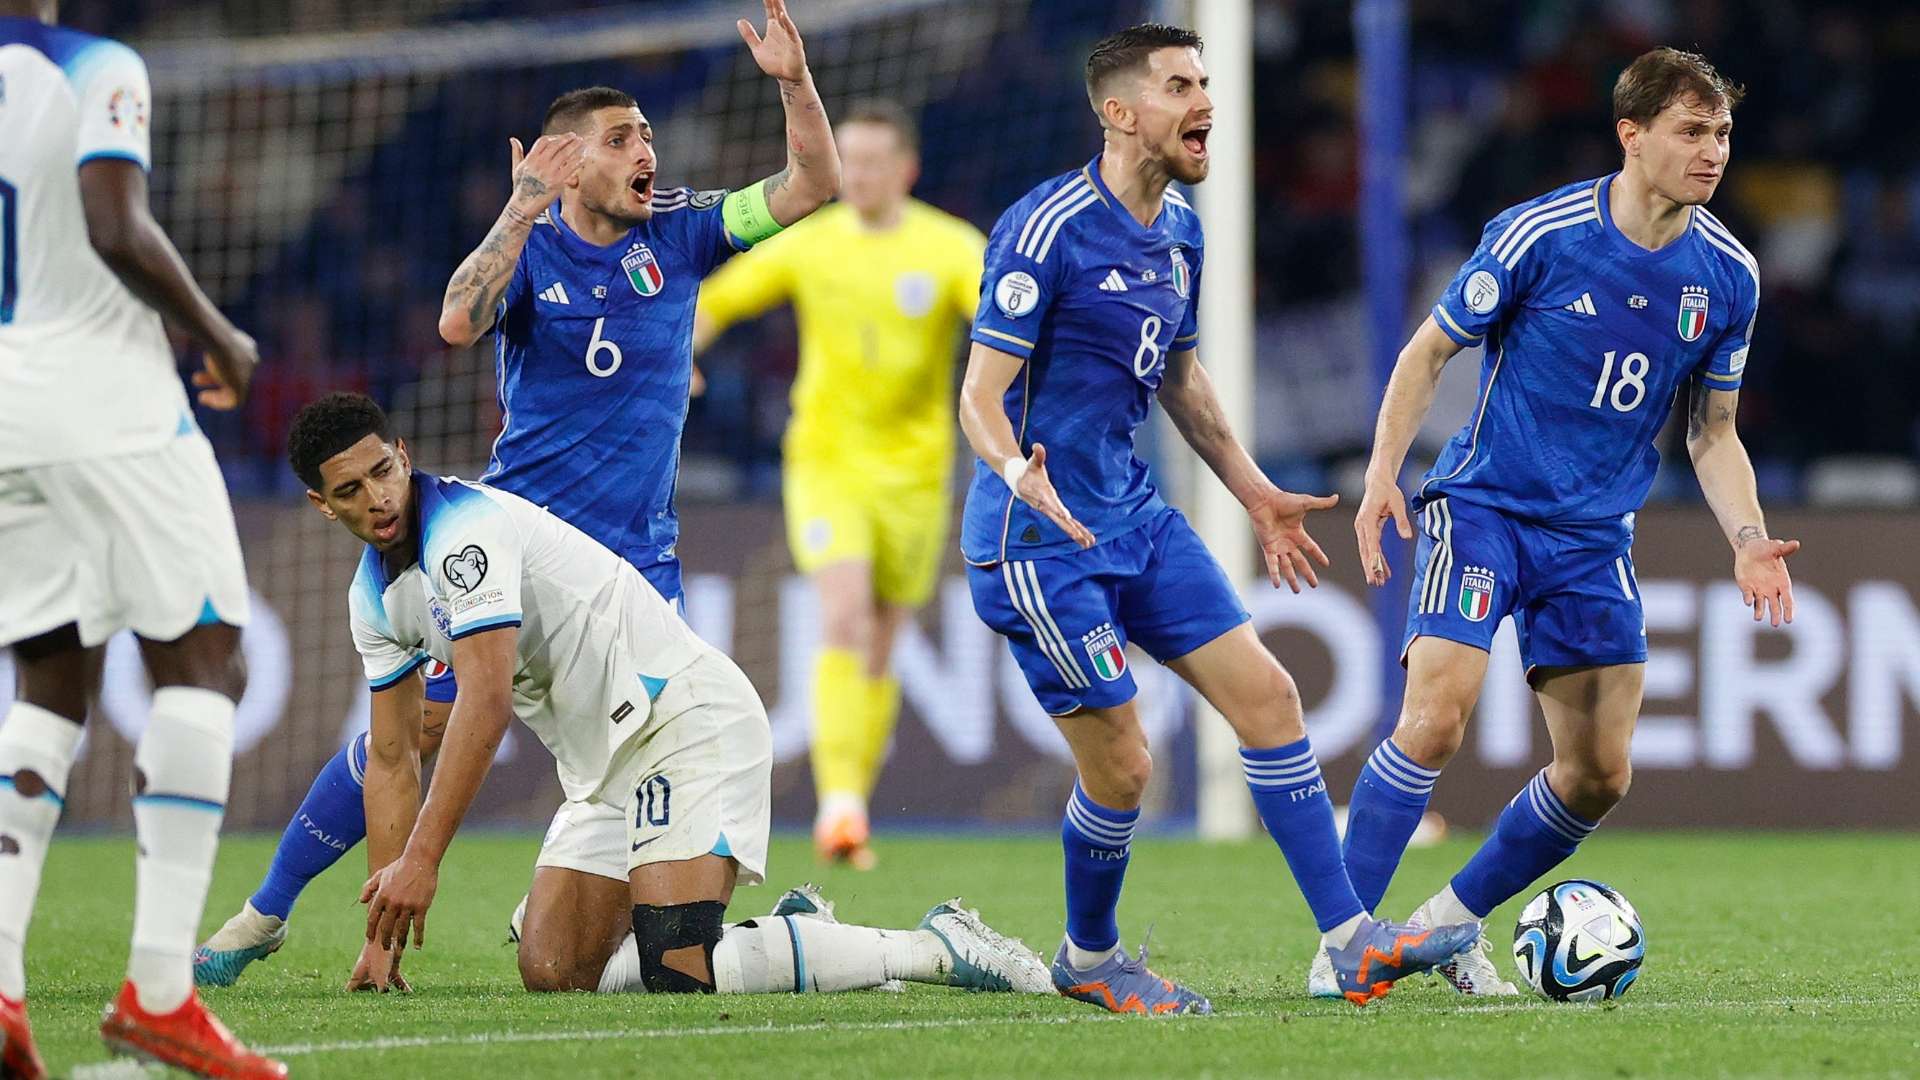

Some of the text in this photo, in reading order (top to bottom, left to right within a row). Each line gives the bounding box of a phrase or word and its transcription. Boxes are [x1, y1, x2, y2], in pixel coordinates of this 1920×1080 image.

[624, 252, 651, 269] ITALIA
[1683, 297, 1706, 309] ITALIA
[585, 317, 623, 378] 6
[1133, 315, 1162, 378] 8
[1590, 350, 1650, 413] 18
[1464, 576, 1491, 591] ITALIA
[1088, 634, 1115, 655] ITALIA
[635, 775, 671, 829] 10
[300, 813, 347, 851] ITALIA
